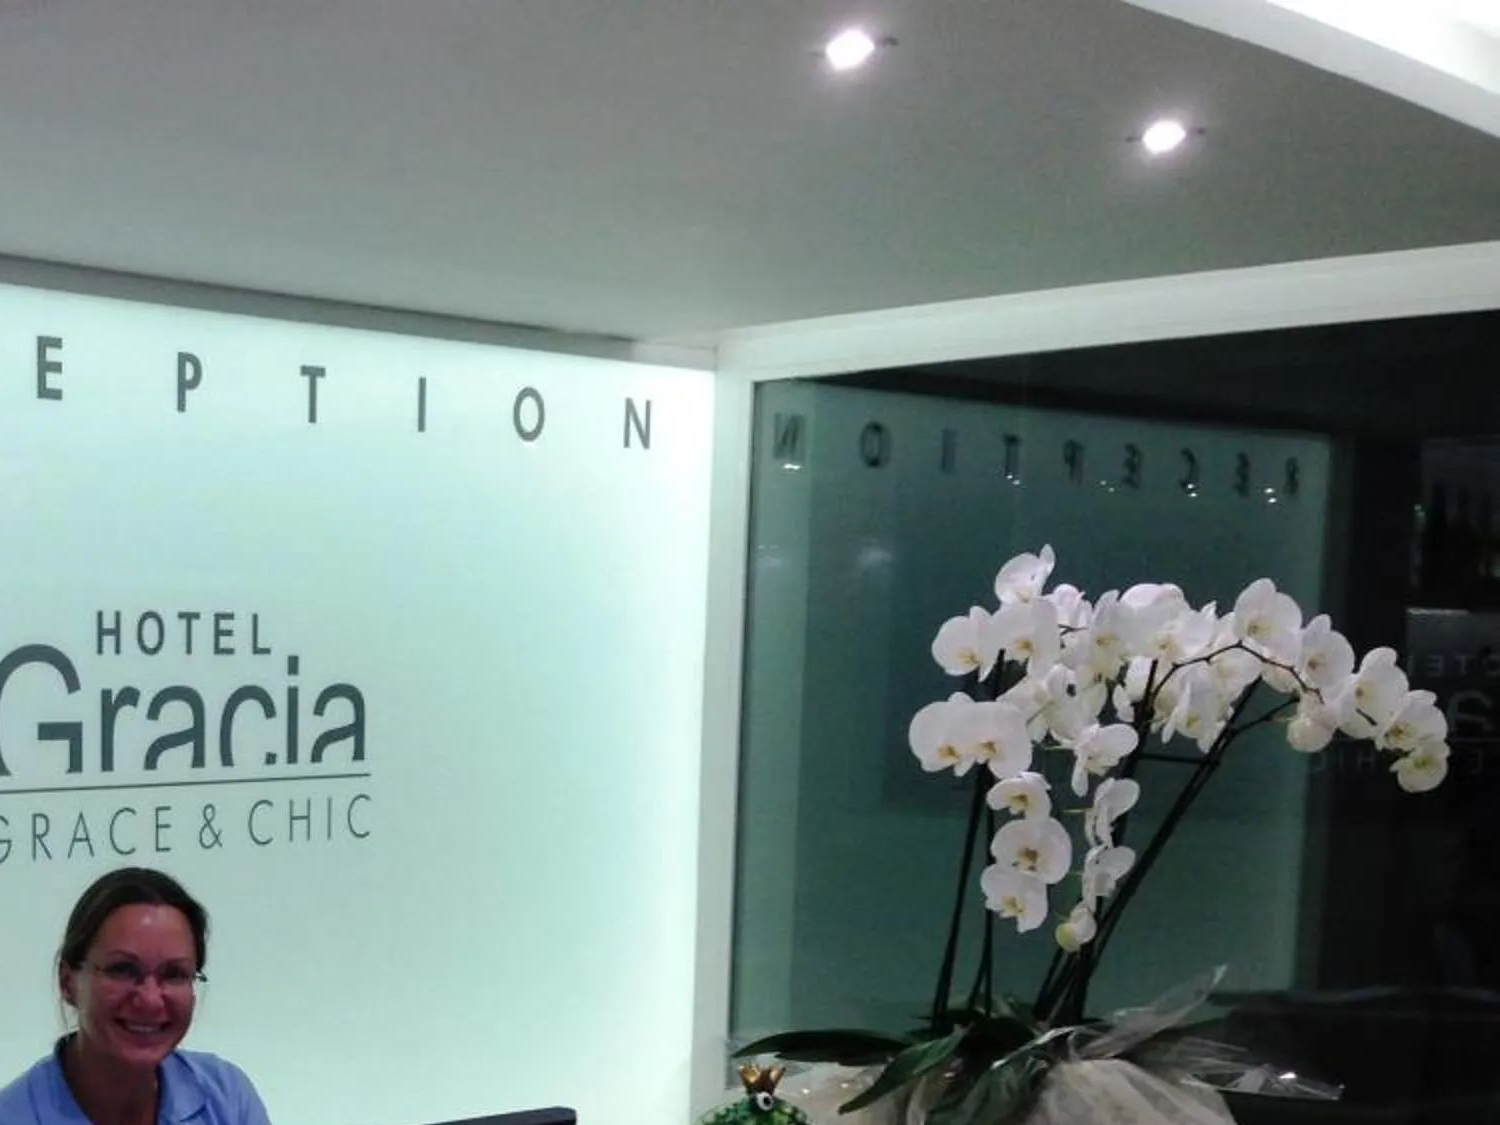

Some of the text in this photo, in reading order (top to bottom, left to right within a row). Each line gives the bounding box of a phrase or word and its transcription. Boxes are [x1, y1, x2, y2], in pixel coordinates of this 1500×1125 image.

[96, 610, 272, 656] HOTEL
[198, 803, 224, 850] &
[247, 793, 372, 846] CHIC
